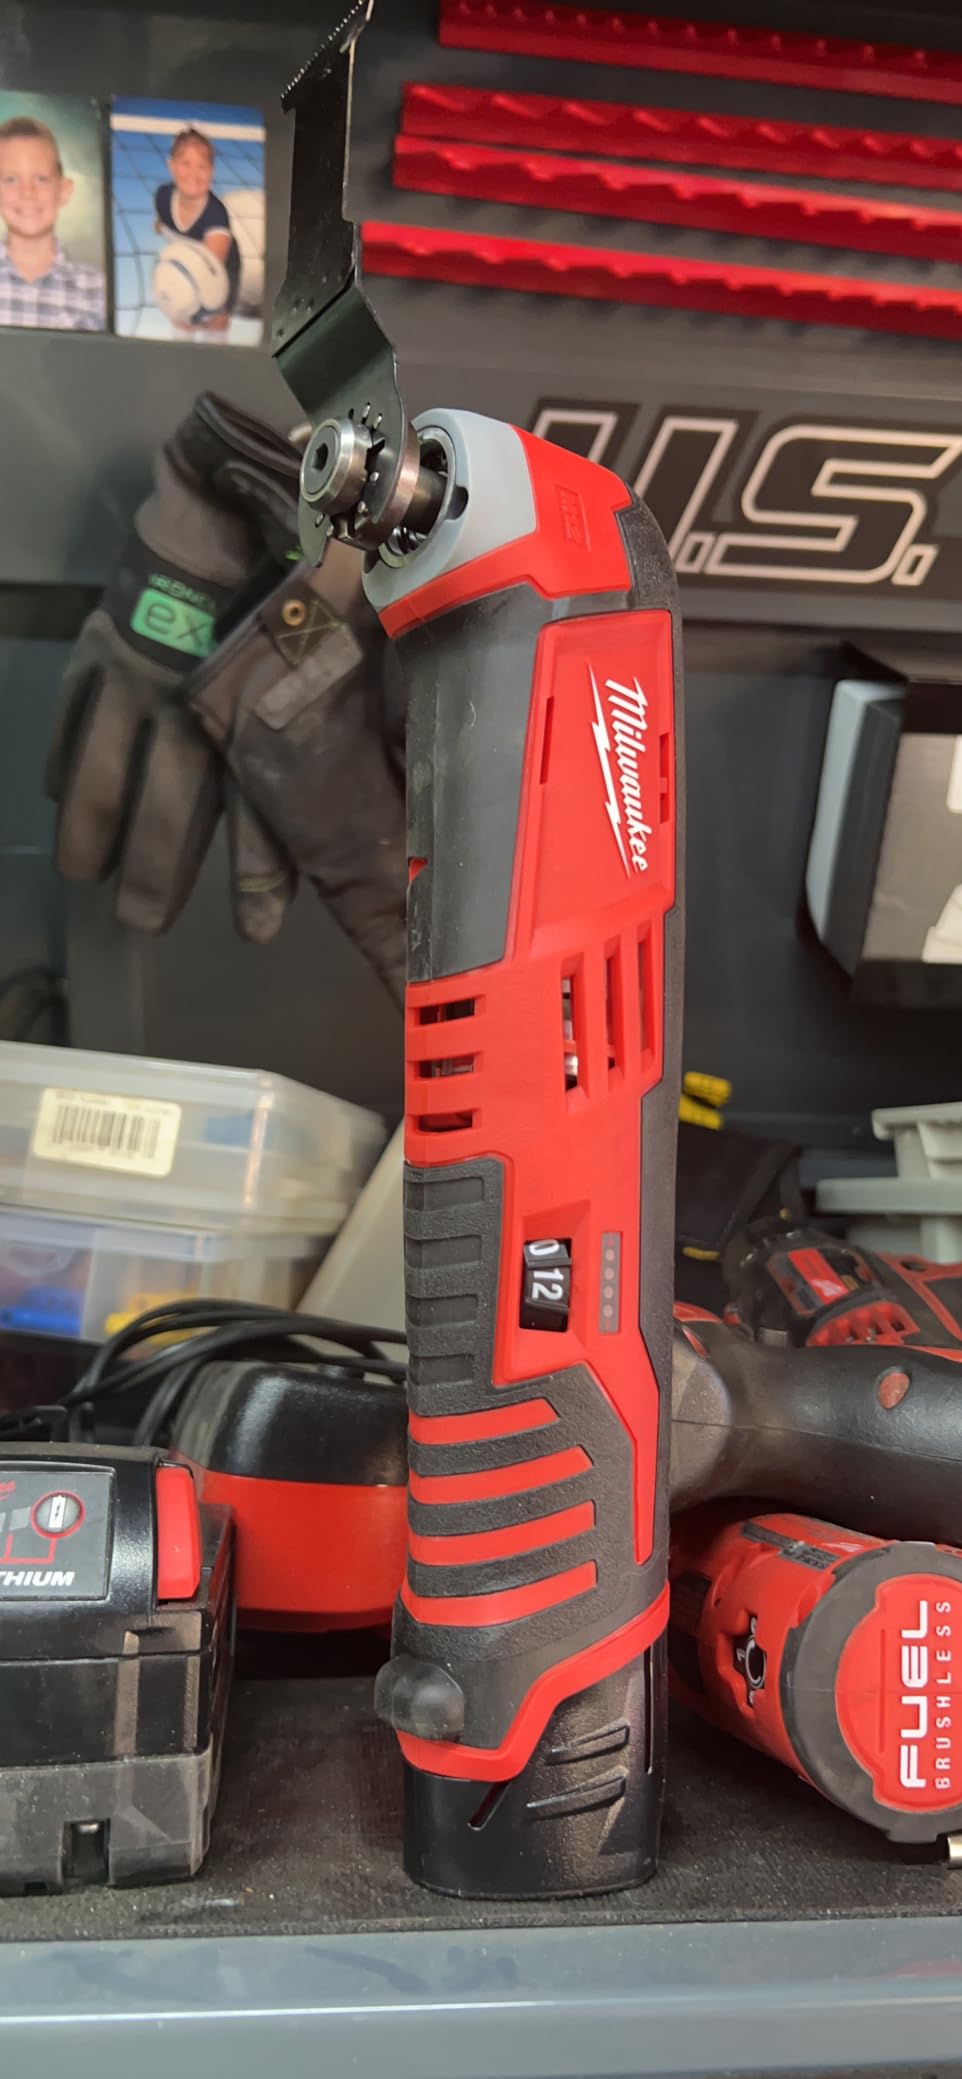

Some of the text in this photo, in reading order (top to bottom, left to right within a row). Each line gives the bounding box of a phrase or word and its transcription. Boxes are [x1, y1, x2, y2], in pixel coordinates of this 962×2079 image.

[604, 675, 652, 873] Milwaukee
[532, 1268, 564, 1300] 12
[900, 1600, 928, 1788] FUEL
[935, 1601, 951, 1789] BRUSHLESS
